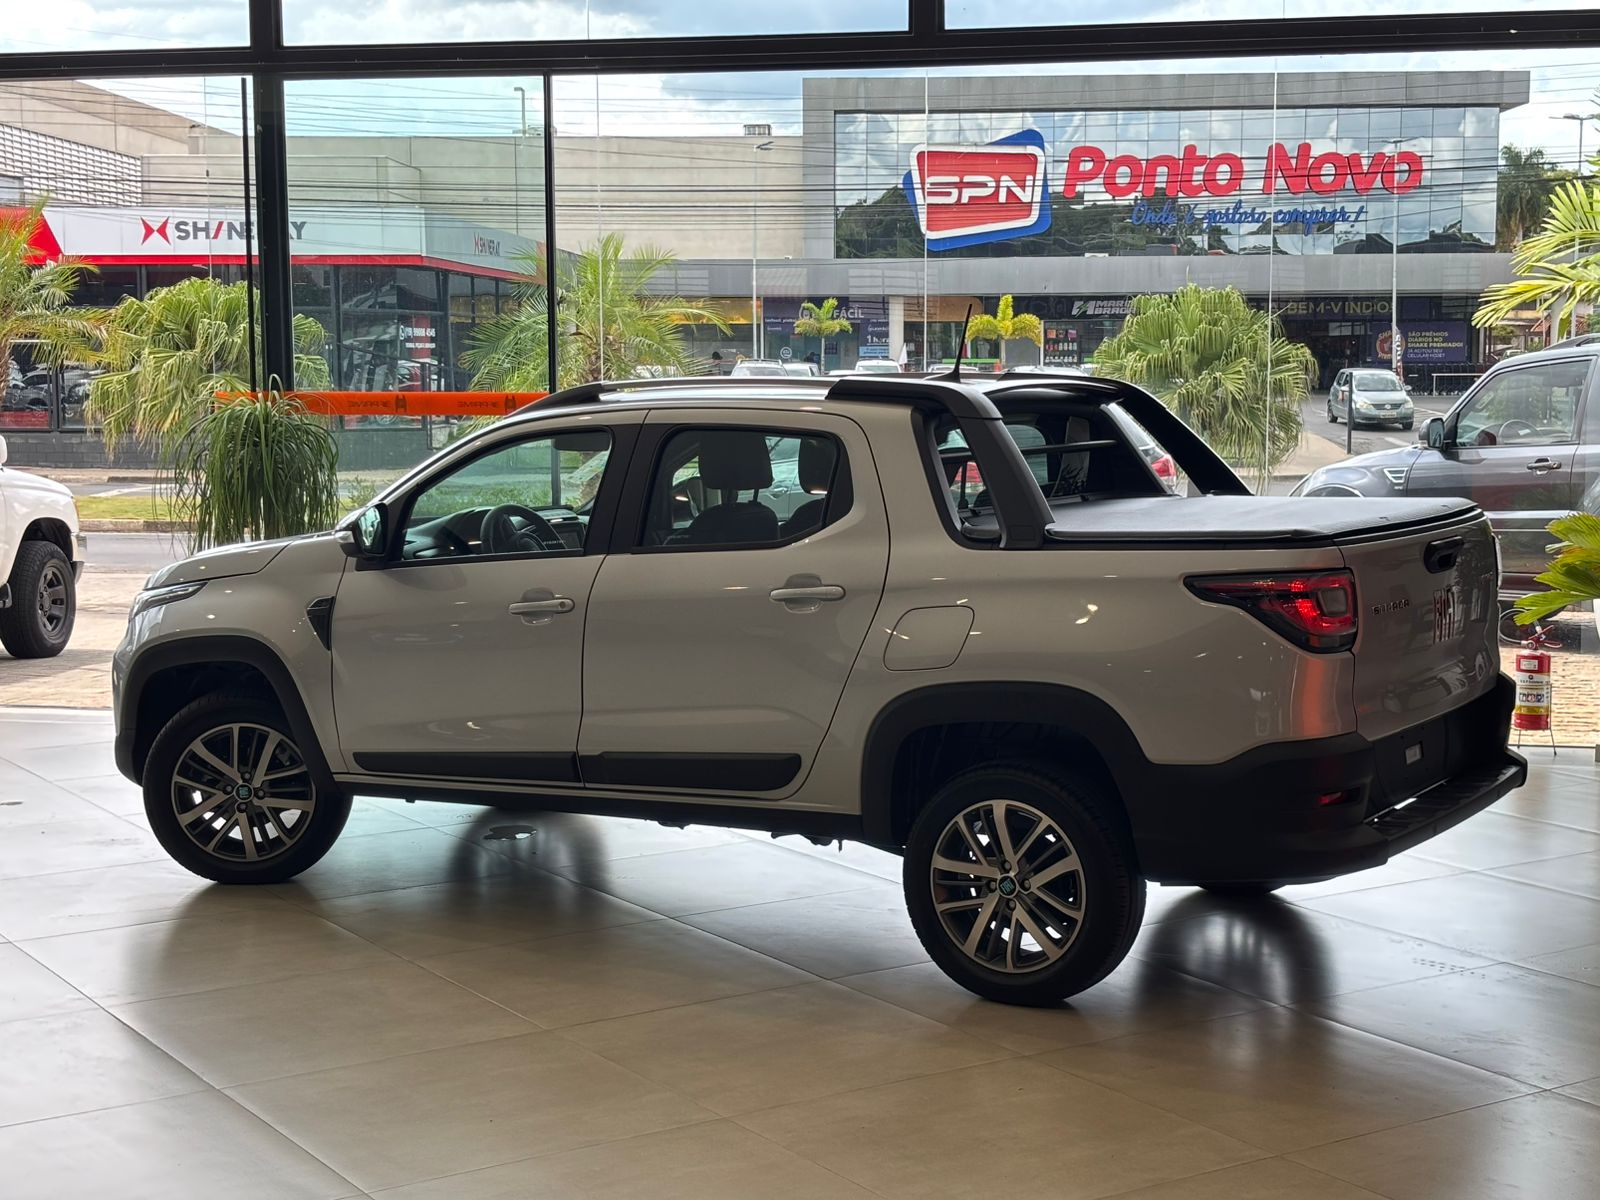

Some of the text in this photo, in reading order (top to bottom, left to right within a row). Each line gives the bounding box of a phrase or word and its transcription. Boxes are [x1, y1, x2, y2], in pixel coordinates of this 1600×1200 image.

[1063, 143, 1424, 198] Ponto Novo
[924, 175, 1034, 204] SPN
[1131, 200, 1178, 225] Onde
[1203, 199, 1267, 232] gostoso
[833, 306, 864, 319] FÁCIL
